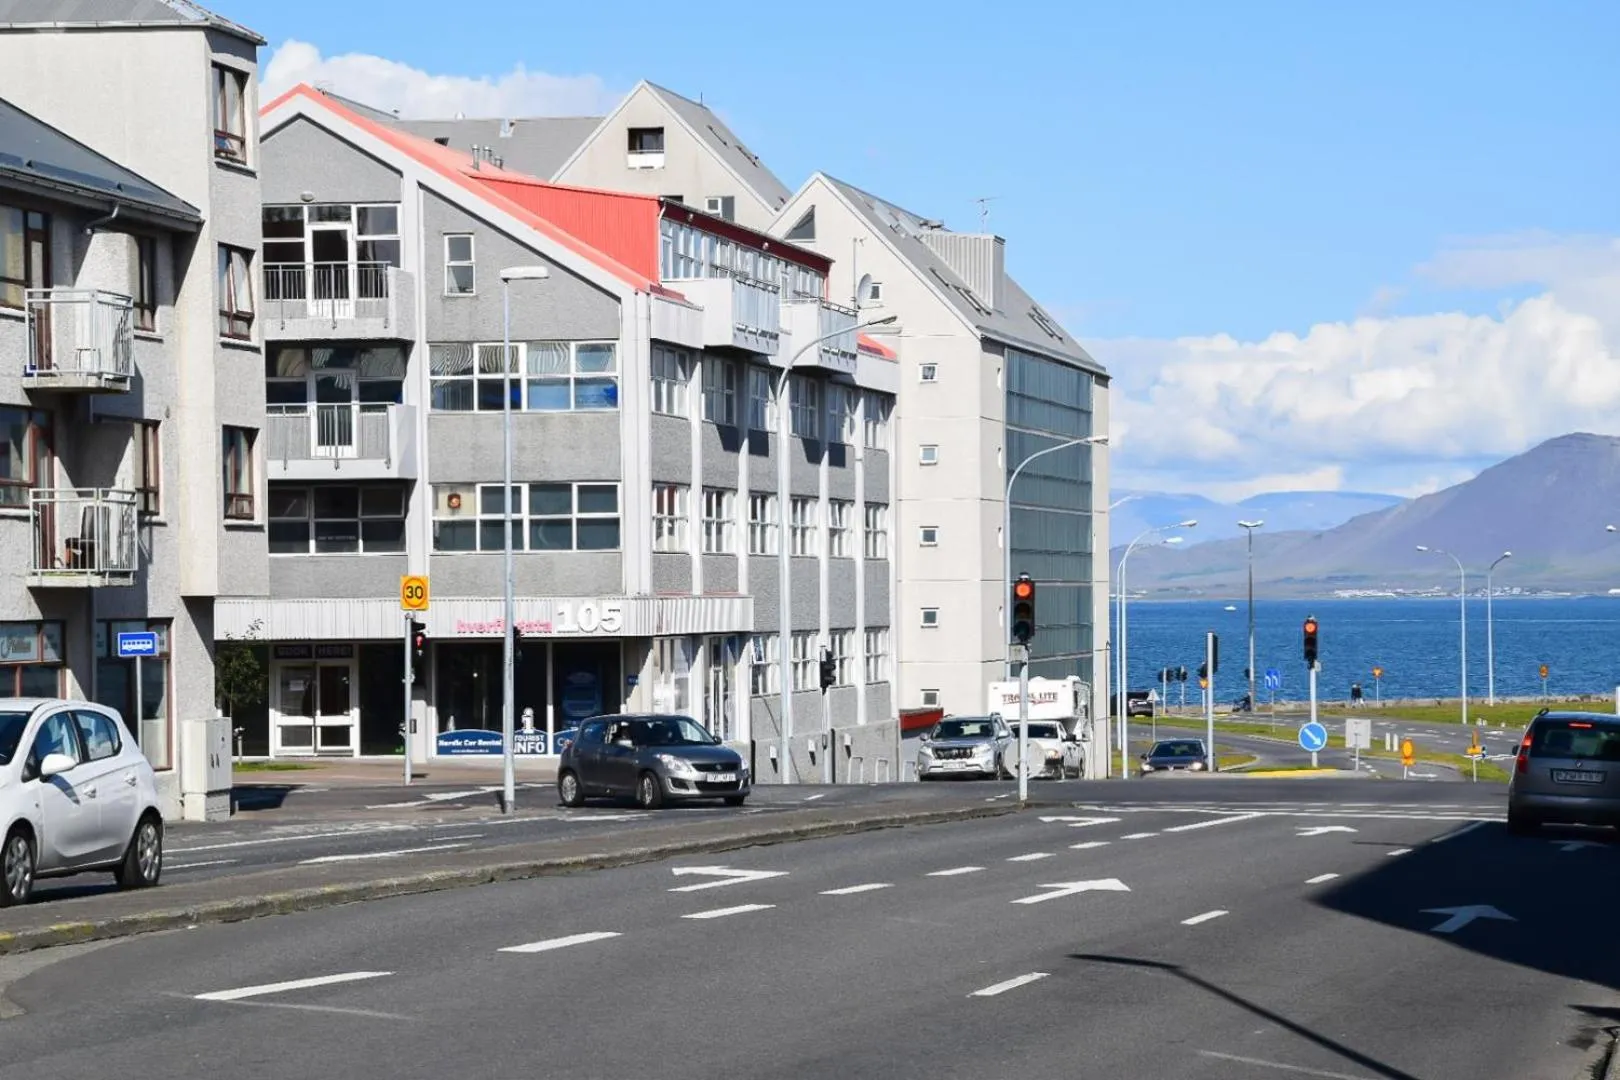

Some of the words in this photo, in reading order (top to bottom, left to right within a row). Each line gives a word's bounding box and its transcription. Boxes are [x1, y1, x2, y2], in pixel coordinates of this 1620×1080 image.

[405, 585, 423, 599] 30
[556, 601, 623, 633] 105
[1002, 692, 1036, 702] TRAL
